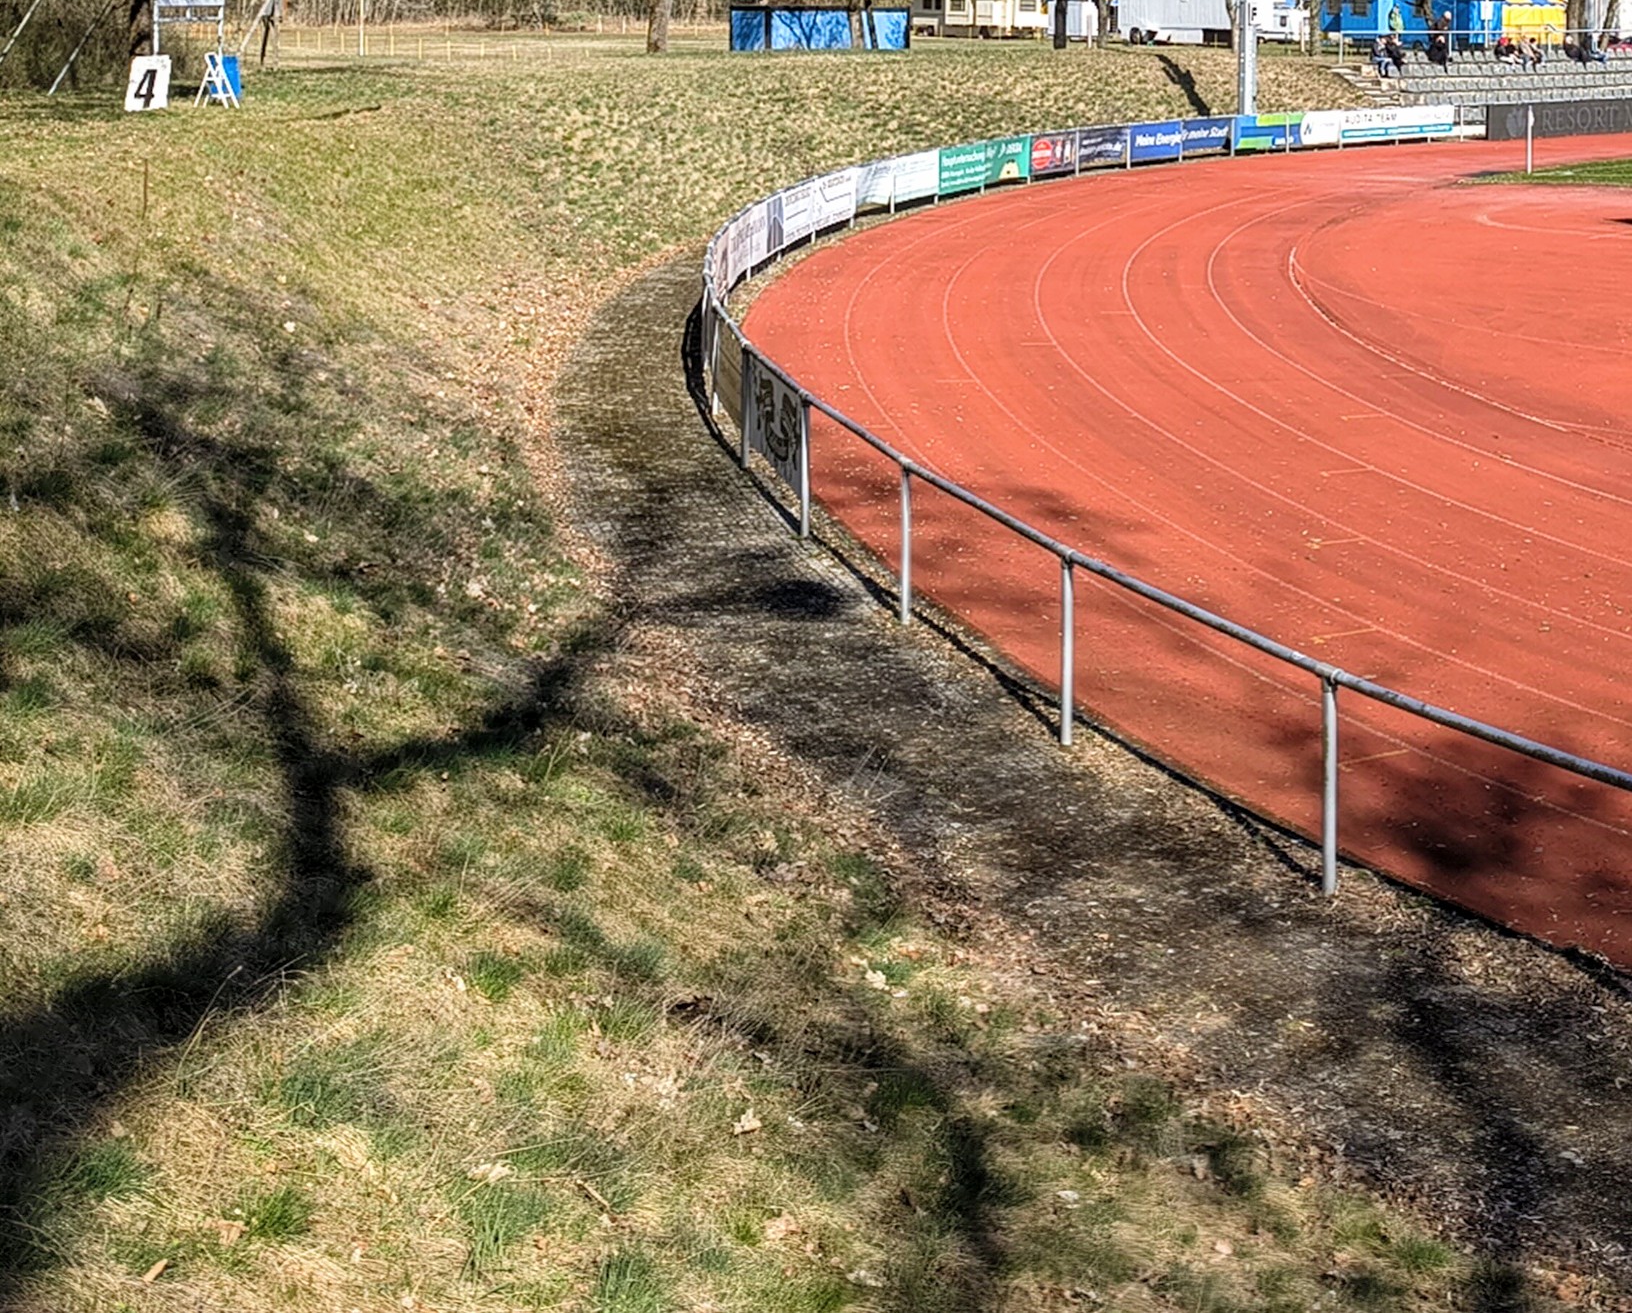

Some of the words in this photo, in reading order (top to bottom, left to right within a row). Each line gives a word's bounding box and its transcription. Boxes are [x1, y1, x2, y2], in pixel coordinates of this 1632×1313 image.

[134, 69, 157, 107] 4
[1541, 103, 1618, 132] RESORT
[1135, 133, 1155, 147] Meine
